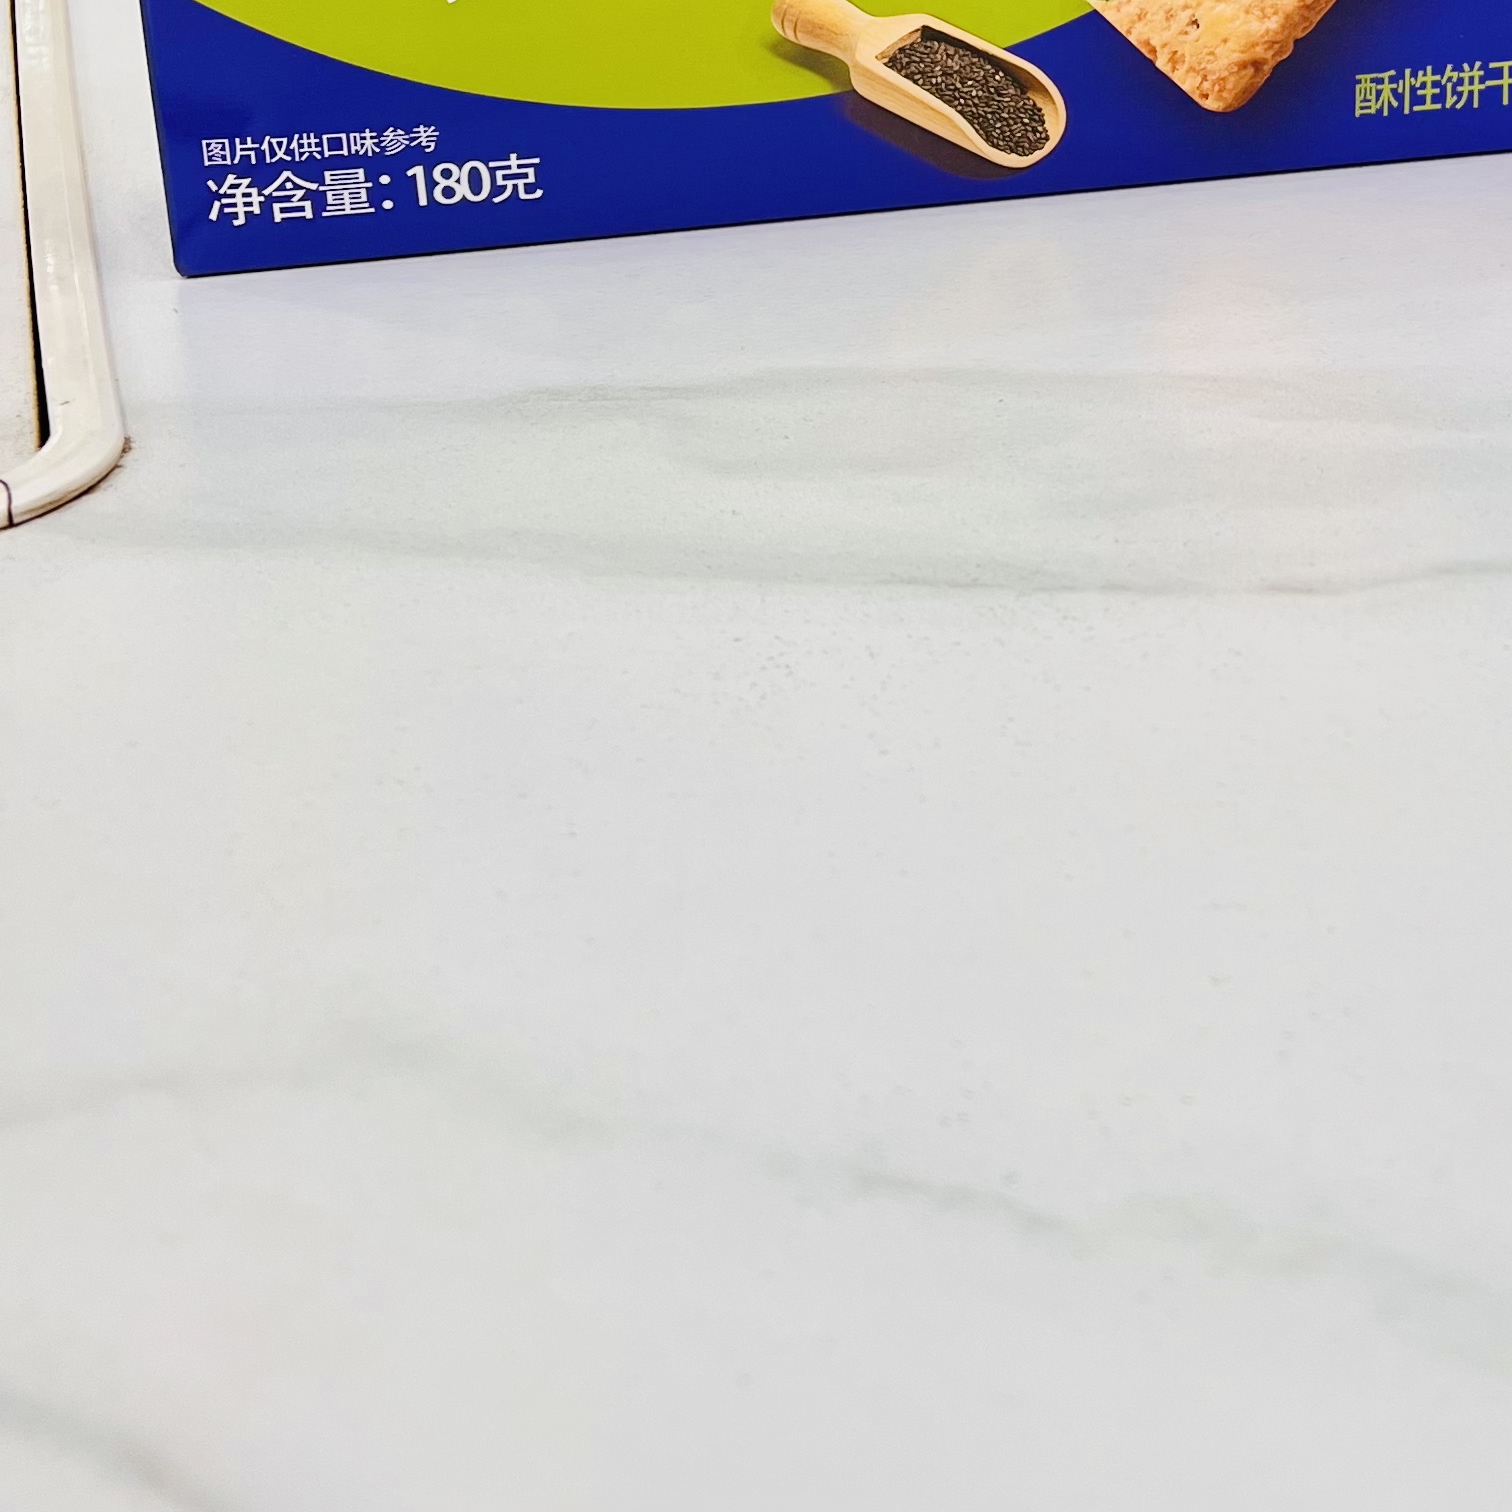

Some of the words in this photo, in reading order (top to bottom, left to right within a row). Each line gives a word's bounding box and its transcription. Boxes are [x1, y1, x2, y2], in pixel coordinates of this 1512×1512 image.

[201, 124, 440, 166] 图片仅供口味参考
